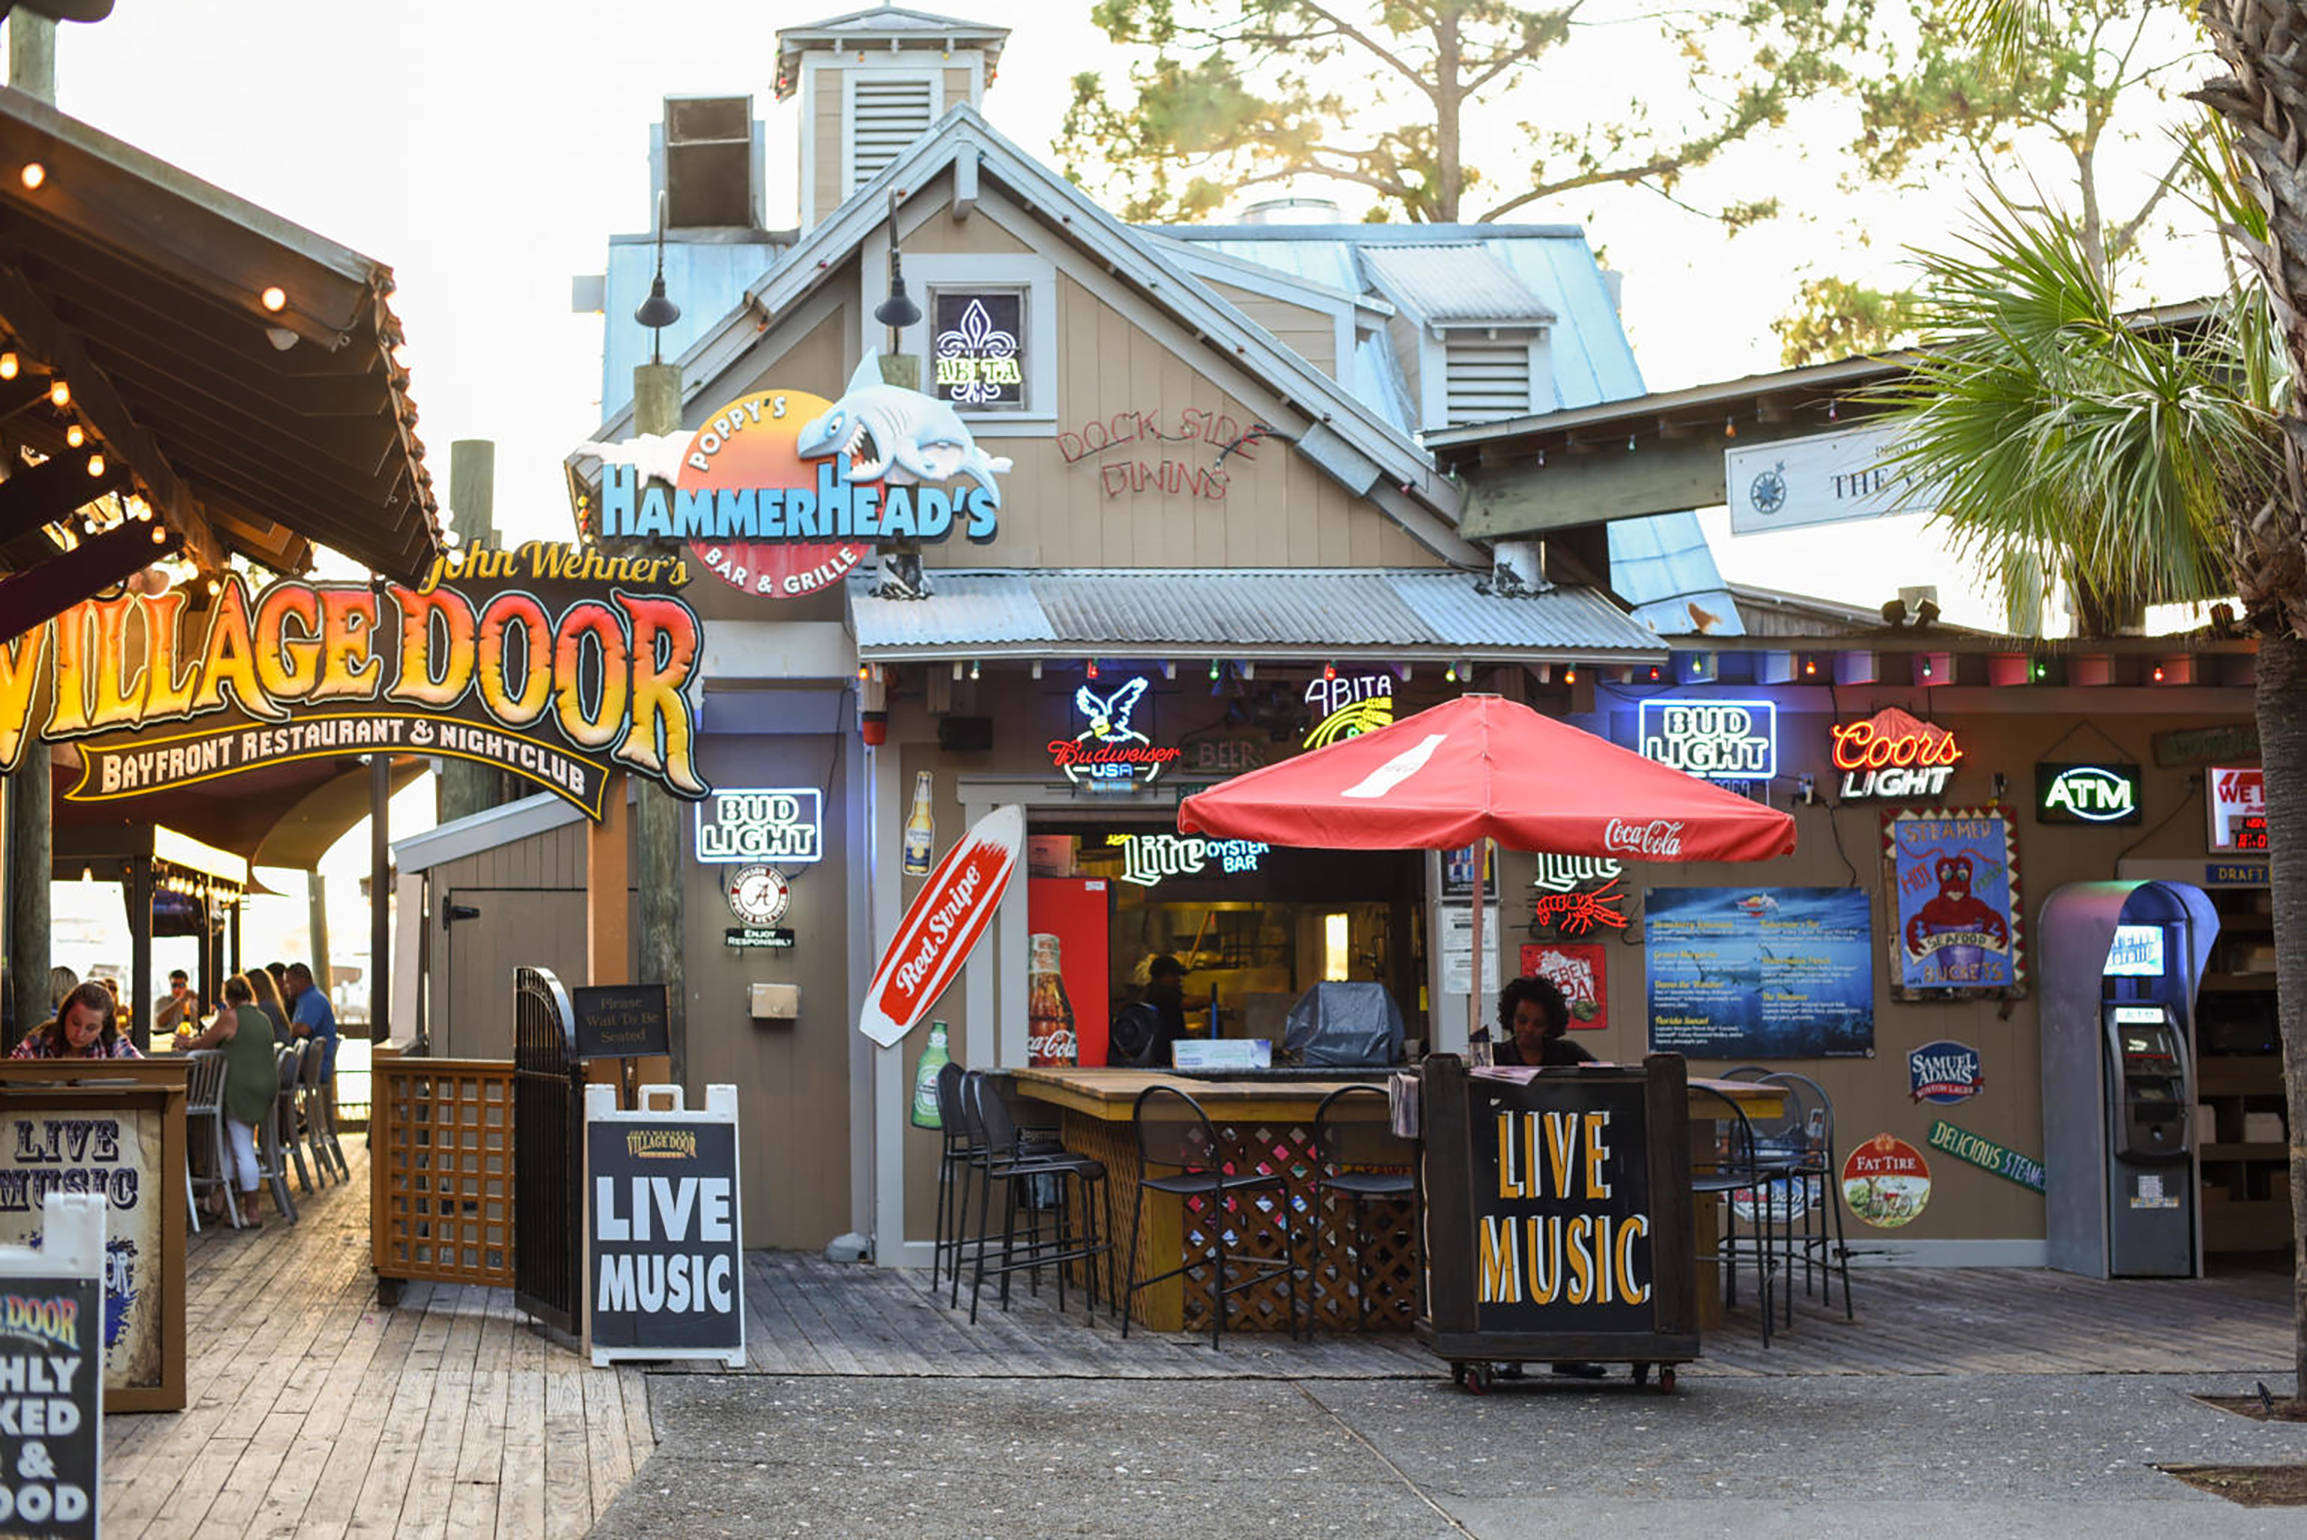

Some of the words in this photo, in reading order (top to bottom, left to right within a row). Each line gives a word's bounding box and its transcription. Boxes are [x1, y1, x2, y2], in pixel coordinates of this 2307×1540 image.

[937, 358, 1021, 384] ABITA
[688, 396, 787, 471] POPPY'S
[1056, 408, 1158, 463] DOCK
[1180, 408, 1261, 461] SIDE
[602, 453, 998, 538] HAMMERHEAD'S
[1103, 459, 1230, 500] DINING
[417, 539, 518, 594] John
[521, 540, 690, 587] Wehner's
[704, 547, 747, 588] BAR
[757, 576, 774, 595] &
[783, 547, 858, 595] GRILLE
[388, 583, 711, 796] DOOR
[1304, 674, 1392, 717] ABITA
[1664, 706, 1751, 739] BUD
[101, 729, 234, 794] BAYFRONT
[242, 718, 404, 762] RESTAURANT
[410, 719, 434, 746] &
[440, 727, 585, 796] NIGHTCLUB
[1048, 740, 1181, 766] Budweiser
[1649, 737, 1769, 771] LIGHT
[1831, 721, 1963, 769] Coors
[1091, 763, 1133, 778] USA
[1840, 766, 1954, 798] LIGHT
[718, 794, 799, 825] BUD
[2045, 777, 2132, 809] ATM
[702, 824, 816, 856] LIGHT
[1603, 817, 1685, 856] Coca-Cola
[1904, 820, 1991, 843] STEAMED
[1121, 834, 1206, 887] Lite
[1206, 840, 1270, 857] OYSTER
[1223, 855, 1258, 873] BAR
[2218, 867, 2264, 881] DRAFT
[744, 929, 776, 938] ENJOY
[895, 936, 940, 998] Red
[929, 865, 981, 944] Stripe
[1927, 932, 1987, 948] SEAFOOD
[1924, 962, 2003, 983] BUCKETS
[585, 1013, 617, 1028] Wait
[622, 1012, 638, 1025] To
[641, 1011, 660, 1025] Be
[600, 997, 643, 1011] Please
[601, 1027, 647, 1044] Seated
[1912, 1053, 1977, 1074] SAMUEL
[1918, 1068, 1973, 1087] ADAMS
[14, 1120, 119, 1163] LIVE
[626, 1135, 668, 1156] VILLAGE
[669, 1135, 697, 1159] DOOR
[1498, 1110, 1612, 1199] LIVE
[1930, 1121, 2003, 1169] DELICIOUS
[1857, 1156, 1881, 1170] FAT
[1882, 1155, 1916, 1170] TIRE
[0, 1168, 138, 1212] MUSIC
[596, 1176, 733, 1242] LIVE
[1478, 1214, 1651, 1305] MUSIC
[598, 1254, 732, 1314] MUSIC
[7, 1295, 81, 1351] DOOR
[17, 1441, 57, 1479] &
